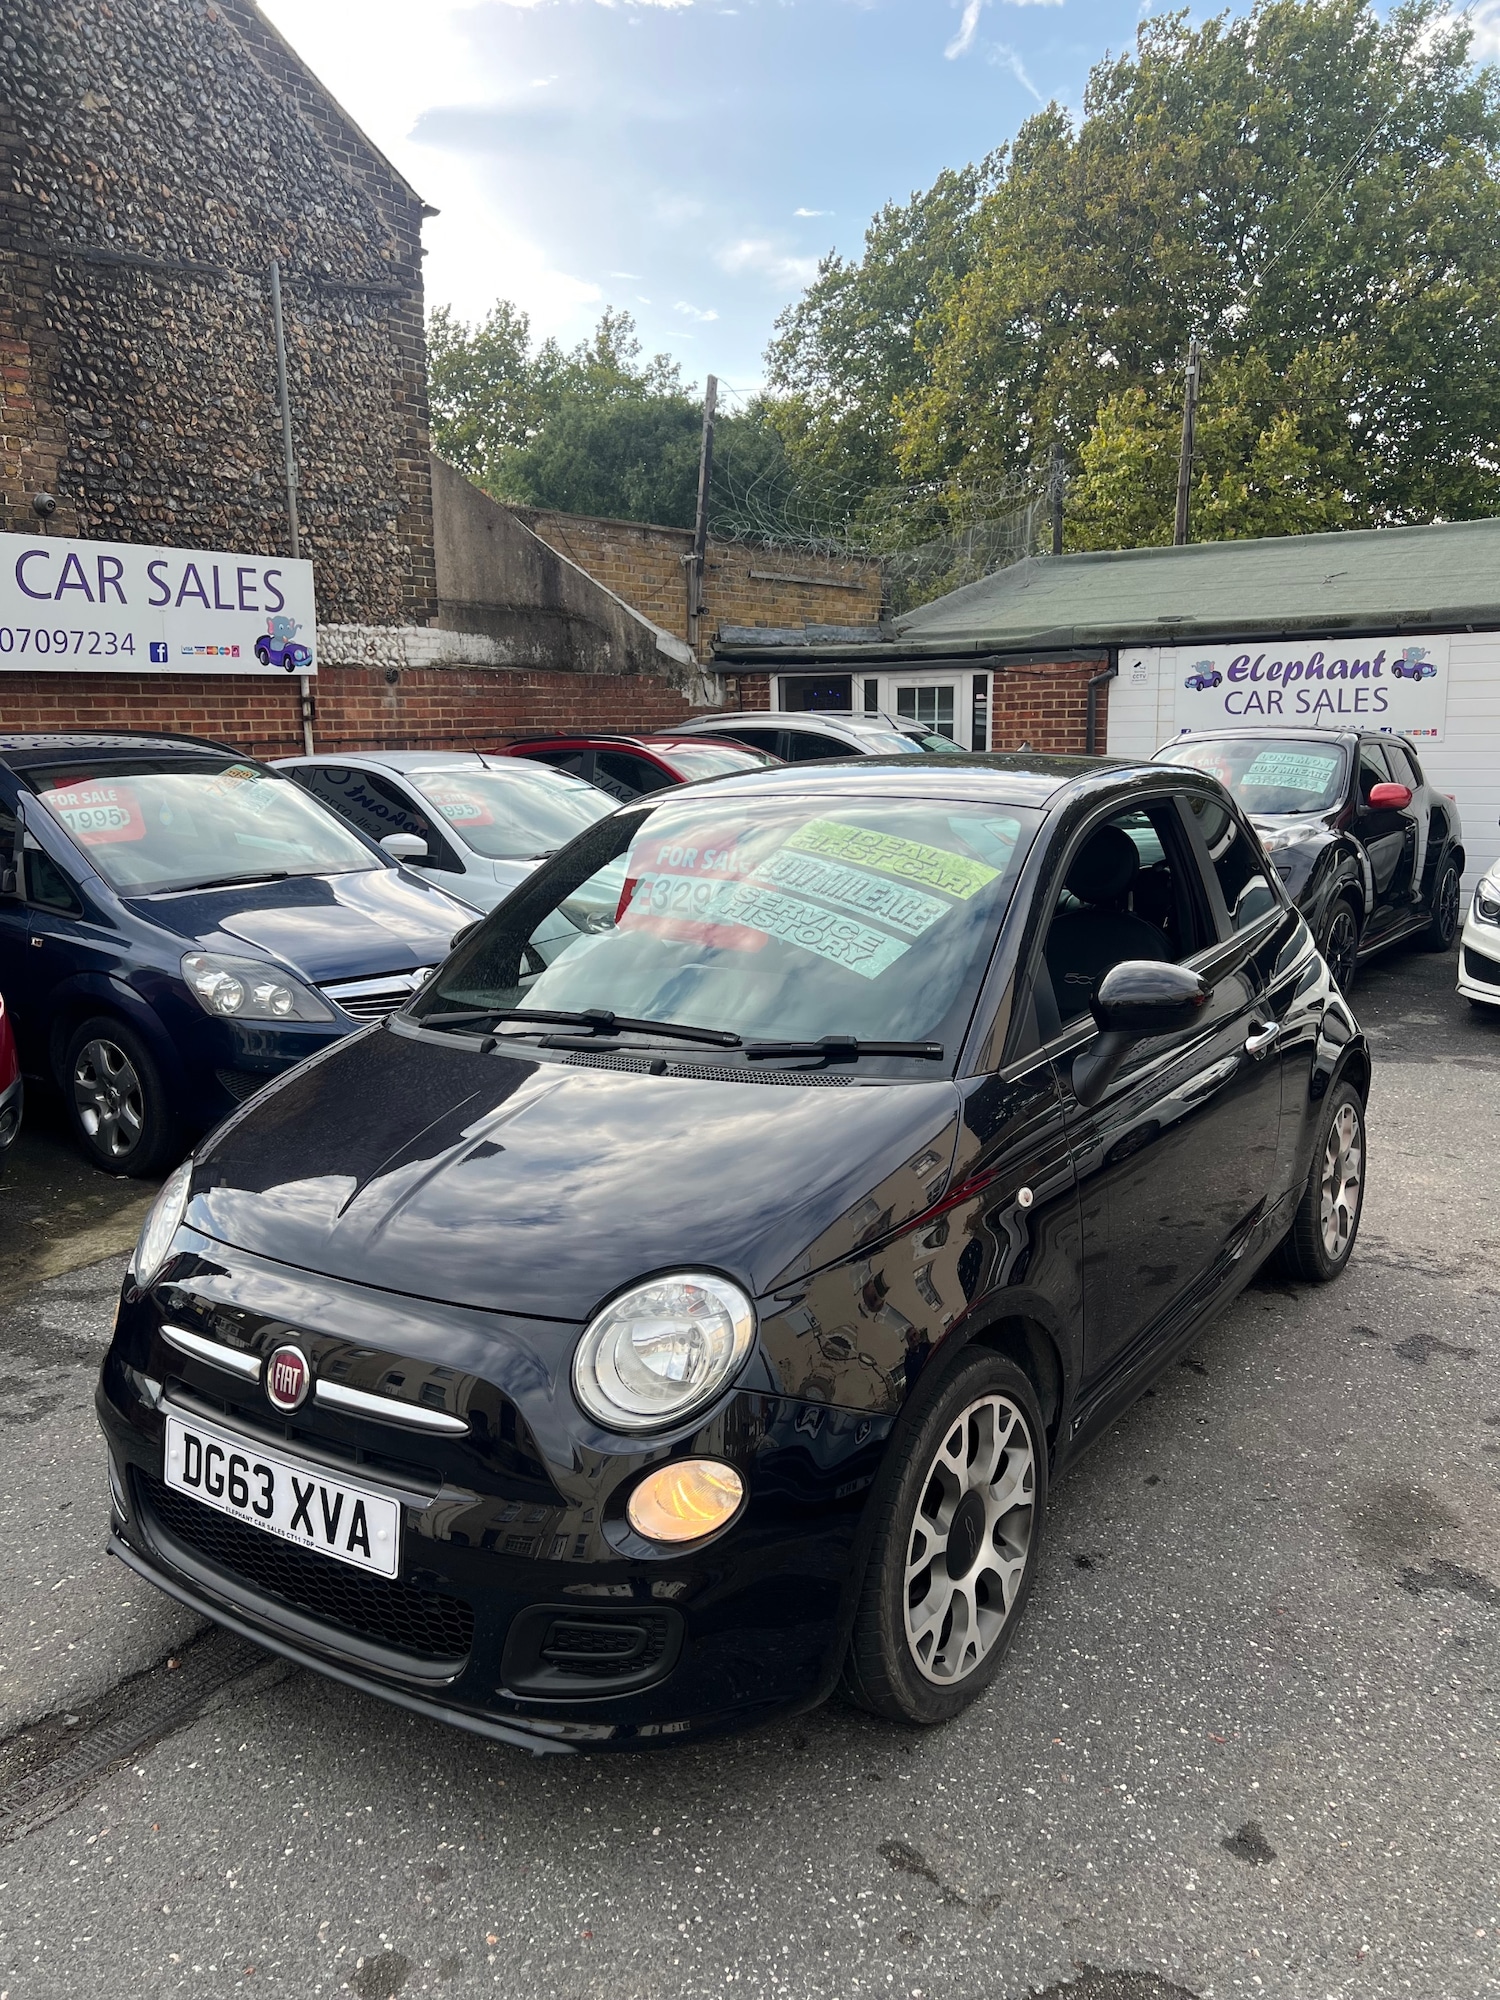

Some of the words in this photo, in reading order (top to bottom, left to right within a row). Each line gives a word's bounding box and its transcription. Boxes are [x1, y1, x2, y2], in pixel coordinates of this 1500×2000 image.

[15, 550, 128, 605] CAR
[147, 560, 285, 613] SALES
[0, 627, 136, 656] 07097234
[1227, 650, 1386, 688] Elephant
[1224, 690, 1284, 715] CAR
[1296, 687, 1388, 714] SALES
[1197, 757, 1221, 767] SALE
[1261, 753, 1294, 764] LONG
[1278, 765, 1331, 781] MILEAGE
[49, 794, 79, 806] FOR
[83, 790, 118, 804] SALE
[65, 808, 122, 829] 1995
[656, 845, 698, 868] FOR
[701, 849, 750, 874] SALE
[848, 829, 940, 865] IDEAL
[791, 833, 892, 865] FIRST
[893, 859, 972, 894] CAR
[813, 868, 940, 931] MILEAGE
[720, 901, 876, 965] HISTORY
[733, 886, 887, 953] SERVICE
[275, 1362, 301, 1396] FIAT
[182, 1432, 274, 1519] DG63
[290, 1476, 371, 1558] XVA
[225, 1506, 253, 1523] ELEPHANT
[254, 1519, 266, 1528] CAR
[266, 1524, 285, 1537] SALES
